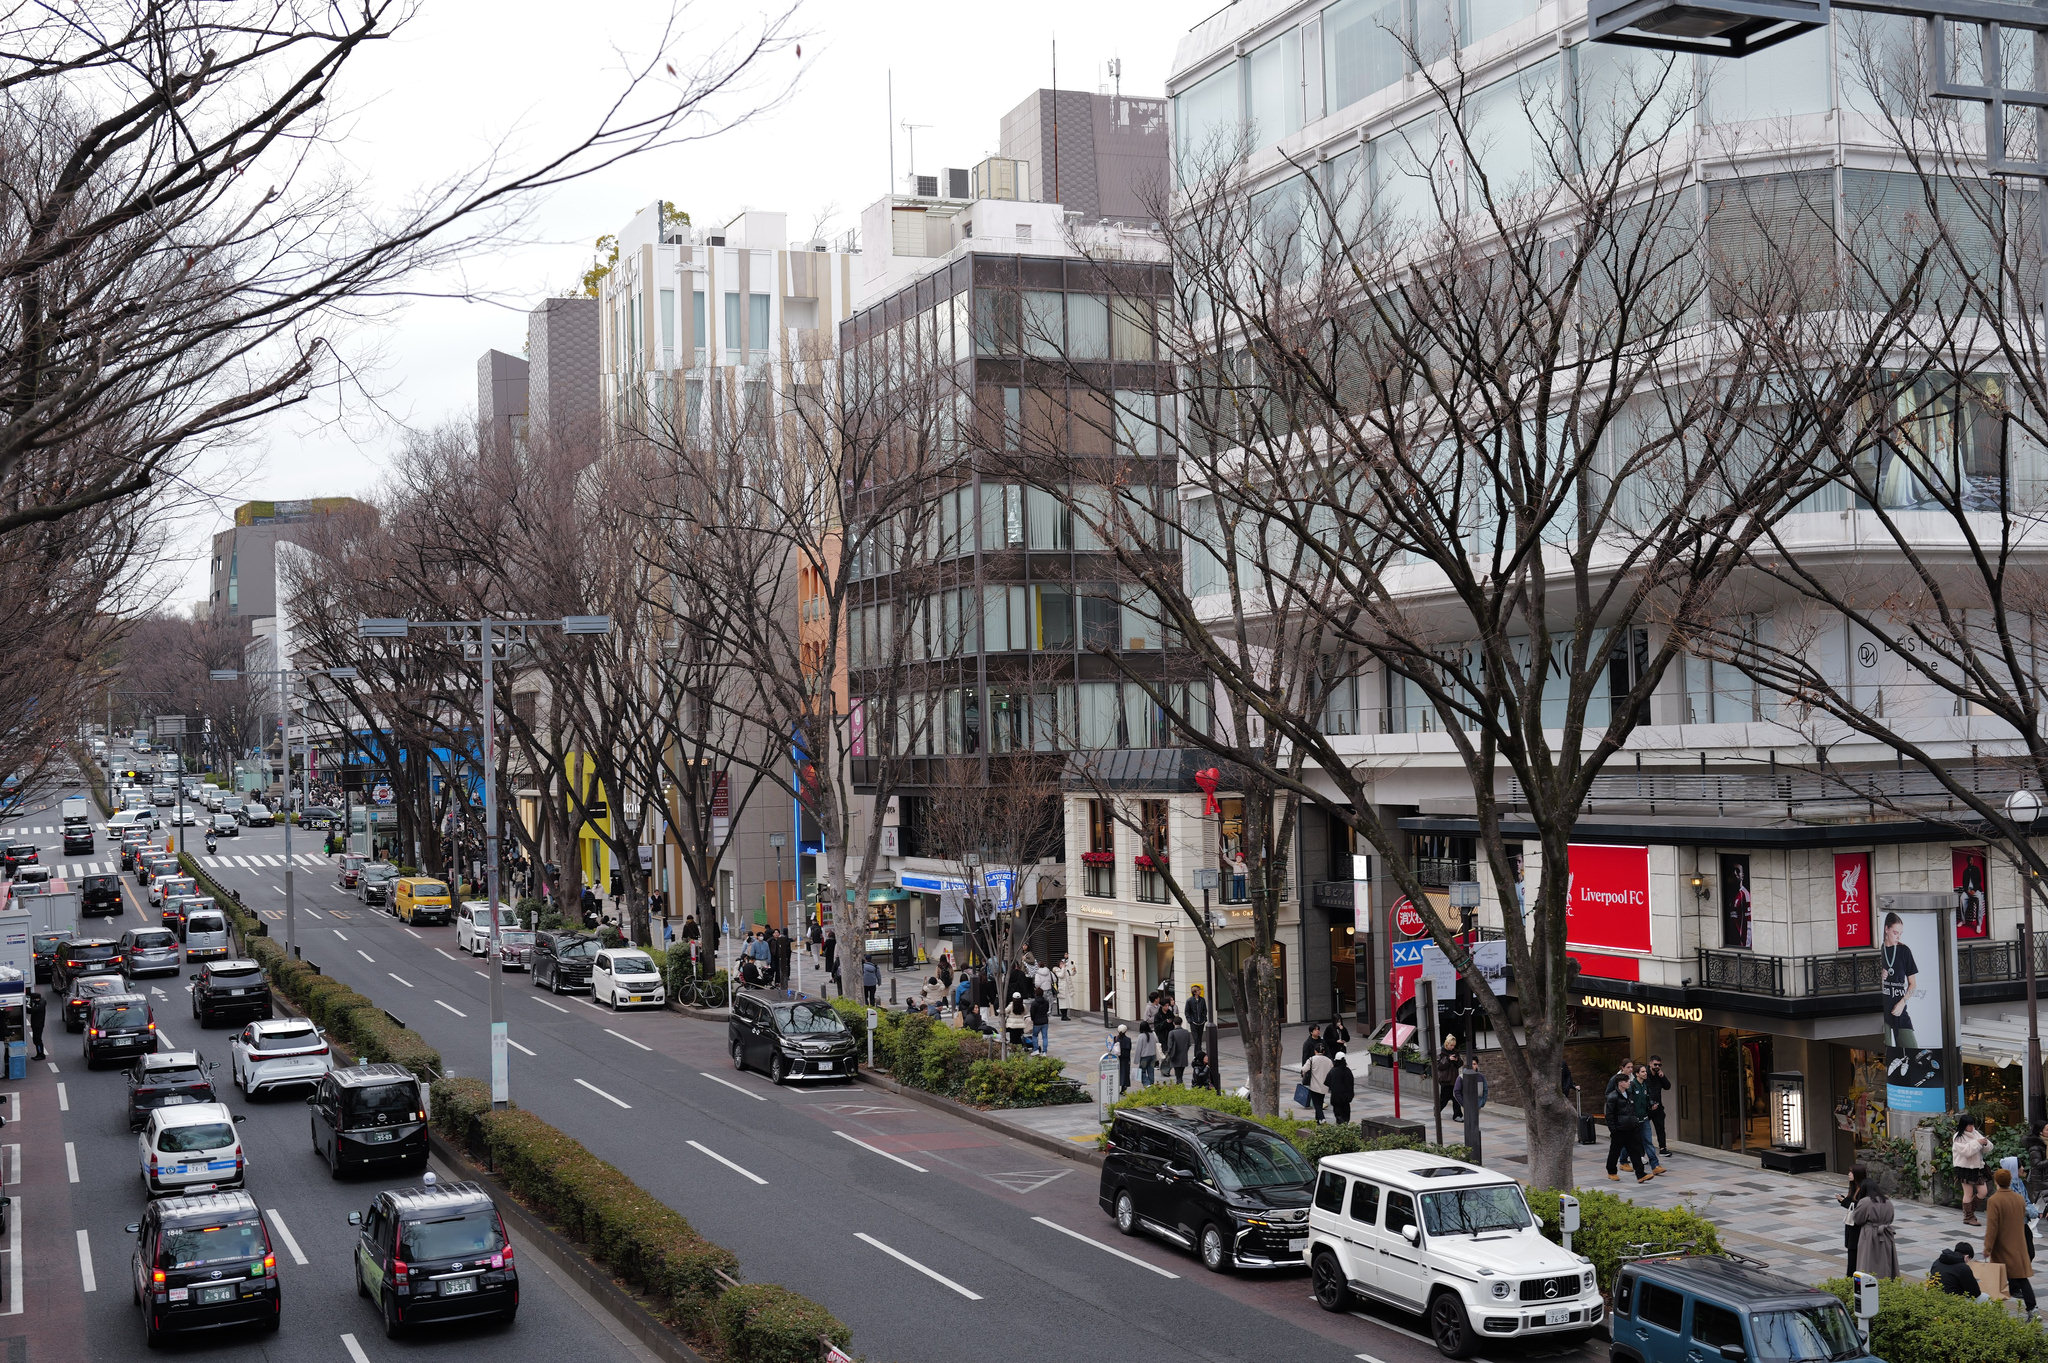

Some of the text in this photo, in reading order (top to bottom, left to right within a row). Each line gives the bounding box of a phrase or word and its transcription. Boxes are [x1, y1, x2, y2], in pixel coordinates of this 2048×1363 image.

[1580, 887, 1645, 906] Liverpool FC
[1846, 923, 1858, 935] 2F
[1582, 995, 1703, 1022] JOURNAL STANDARD
[1550, 1313, 1569, 1323] 76-95
